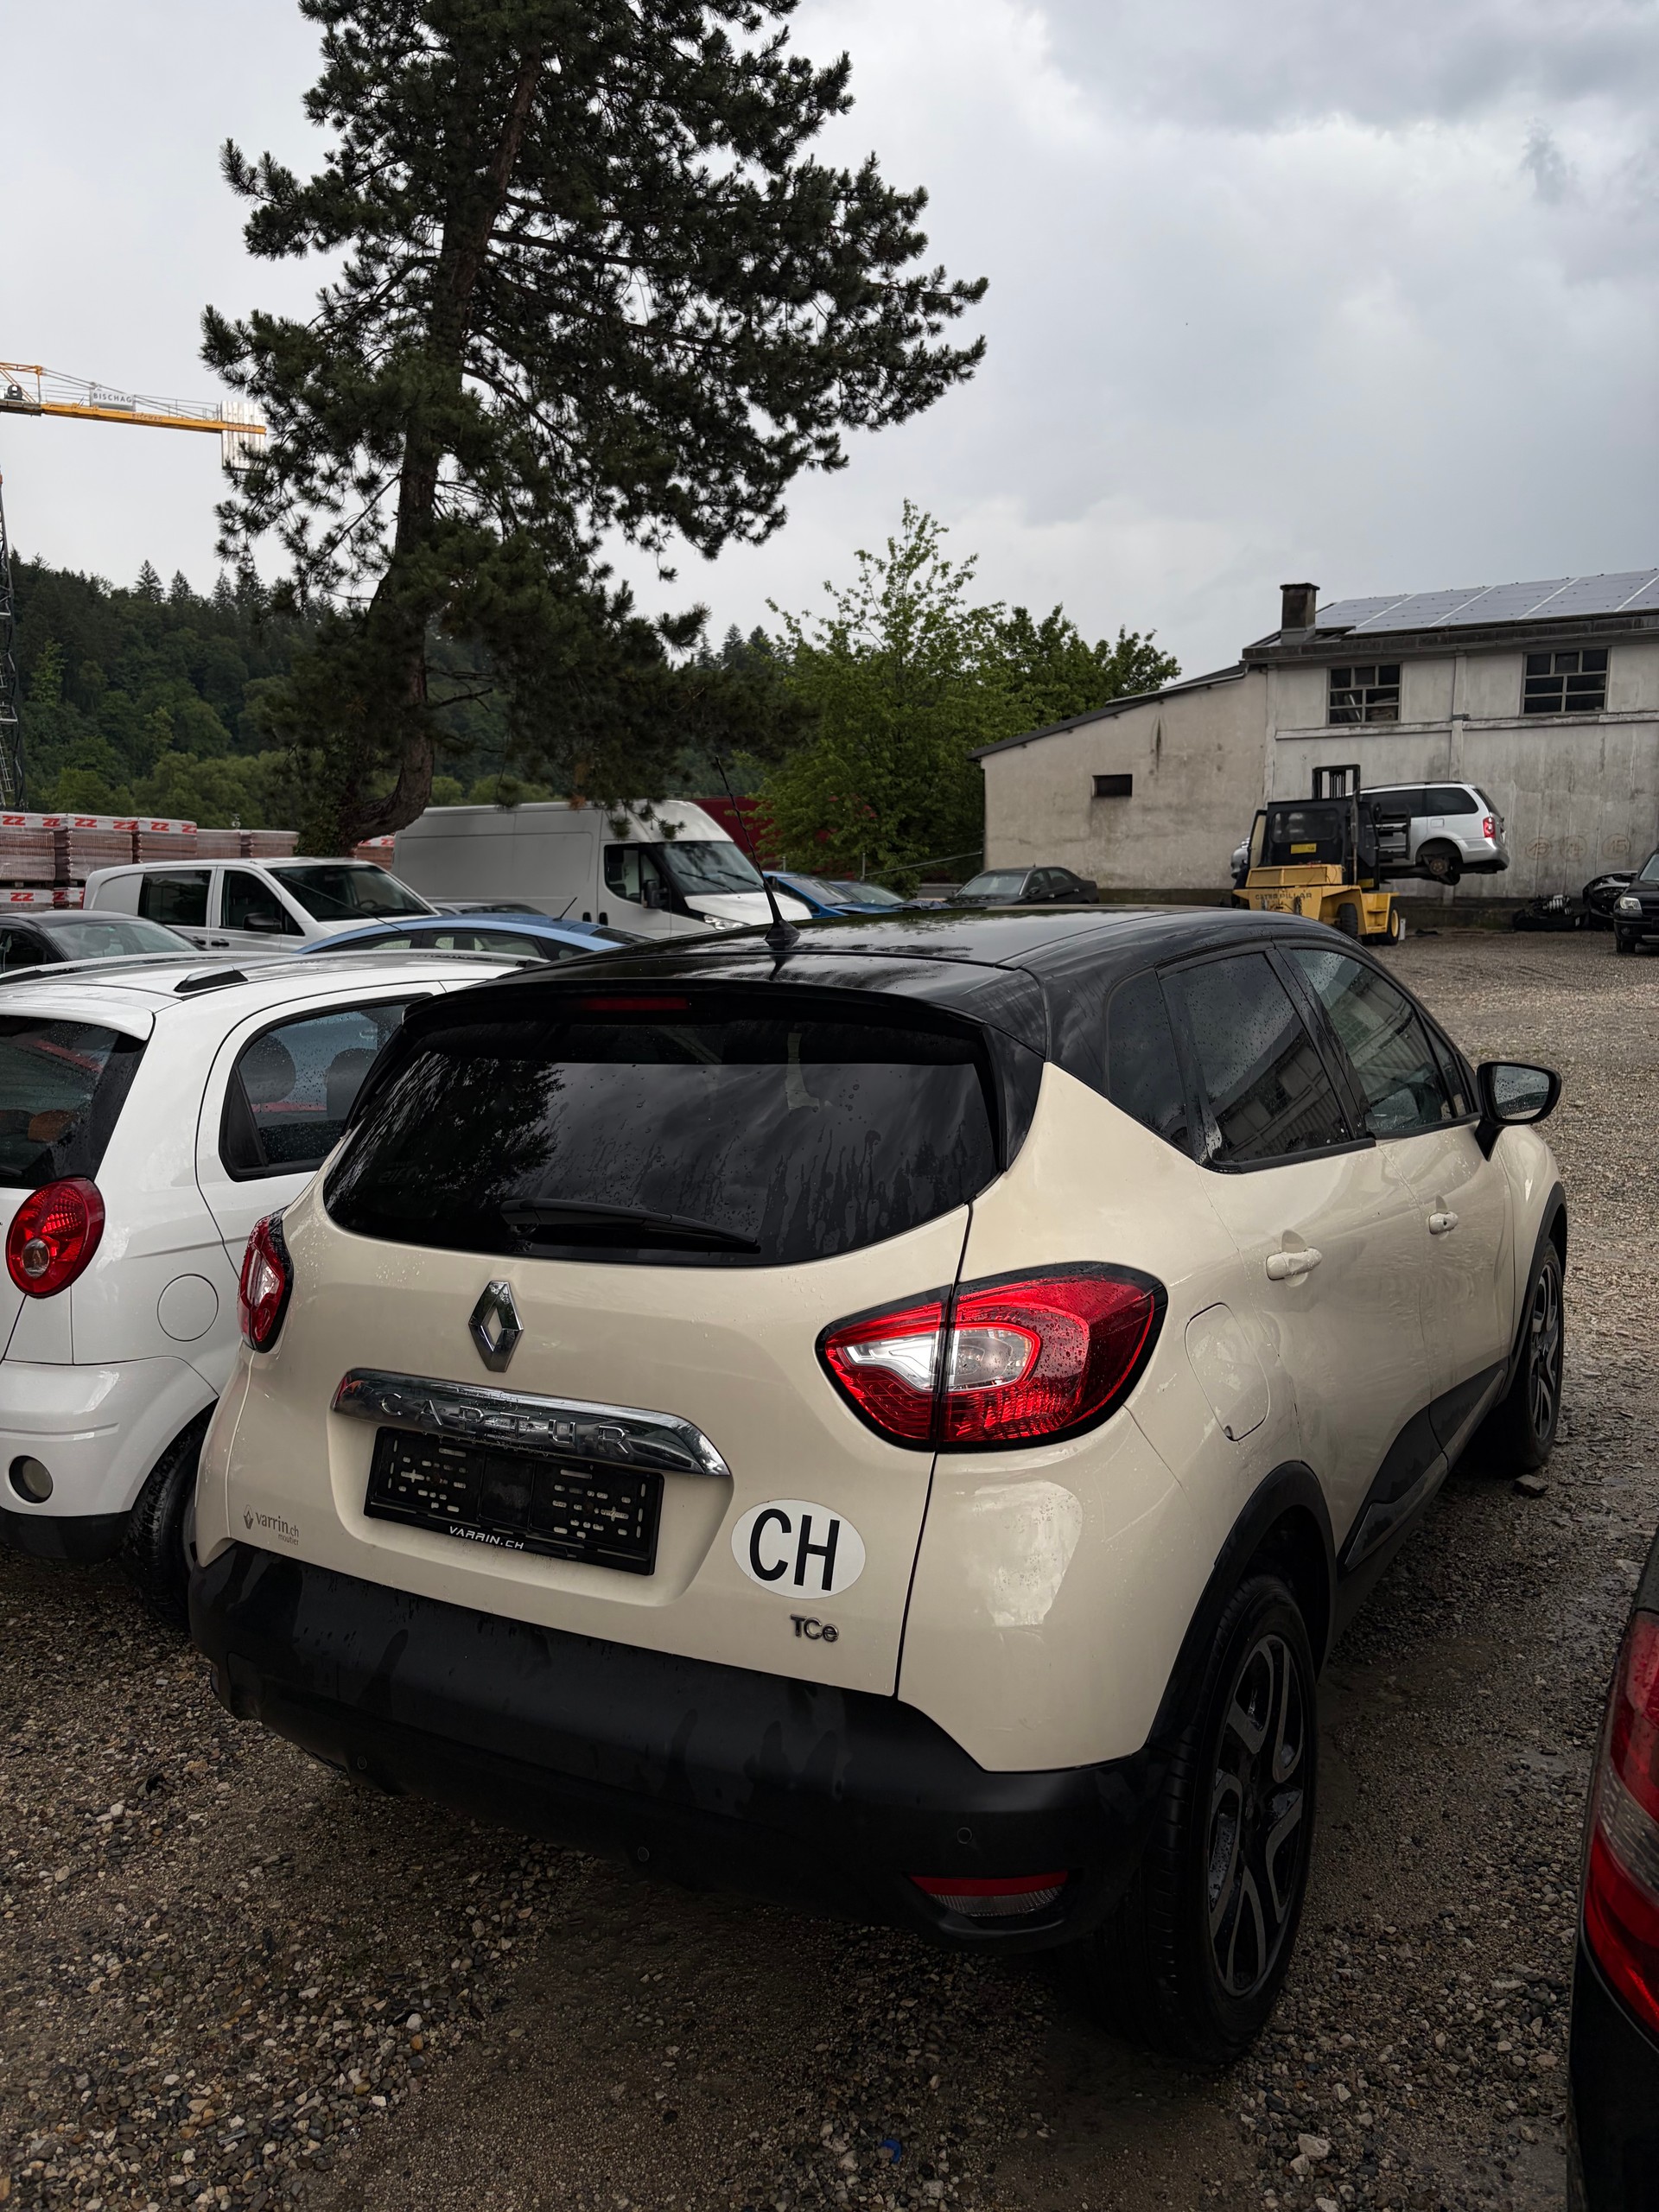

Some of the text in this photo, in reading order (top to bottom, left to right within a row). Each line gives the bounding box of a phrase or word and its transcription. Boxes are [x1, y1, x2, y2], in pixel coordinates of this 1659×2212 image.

[92, 392, 132, 403] BISCHAG
[3, 816, 26, 826] ZZ
[74, 817, 98, 828] ZZ
[150, 822, 169, 831] ZZ
[10, 893, 35, 901] ZZ
[380, 1393, 629, 1454] CAPTUR
[255, 1512, 300, 1537] varrin.ch
[277, 1534, 300, 1546] moutier
[449, 1526, 524, 1549] VARRIN.CH
[749, 1508, 840, 1592] CH
[790, 1614, 840, 1643] TCe
